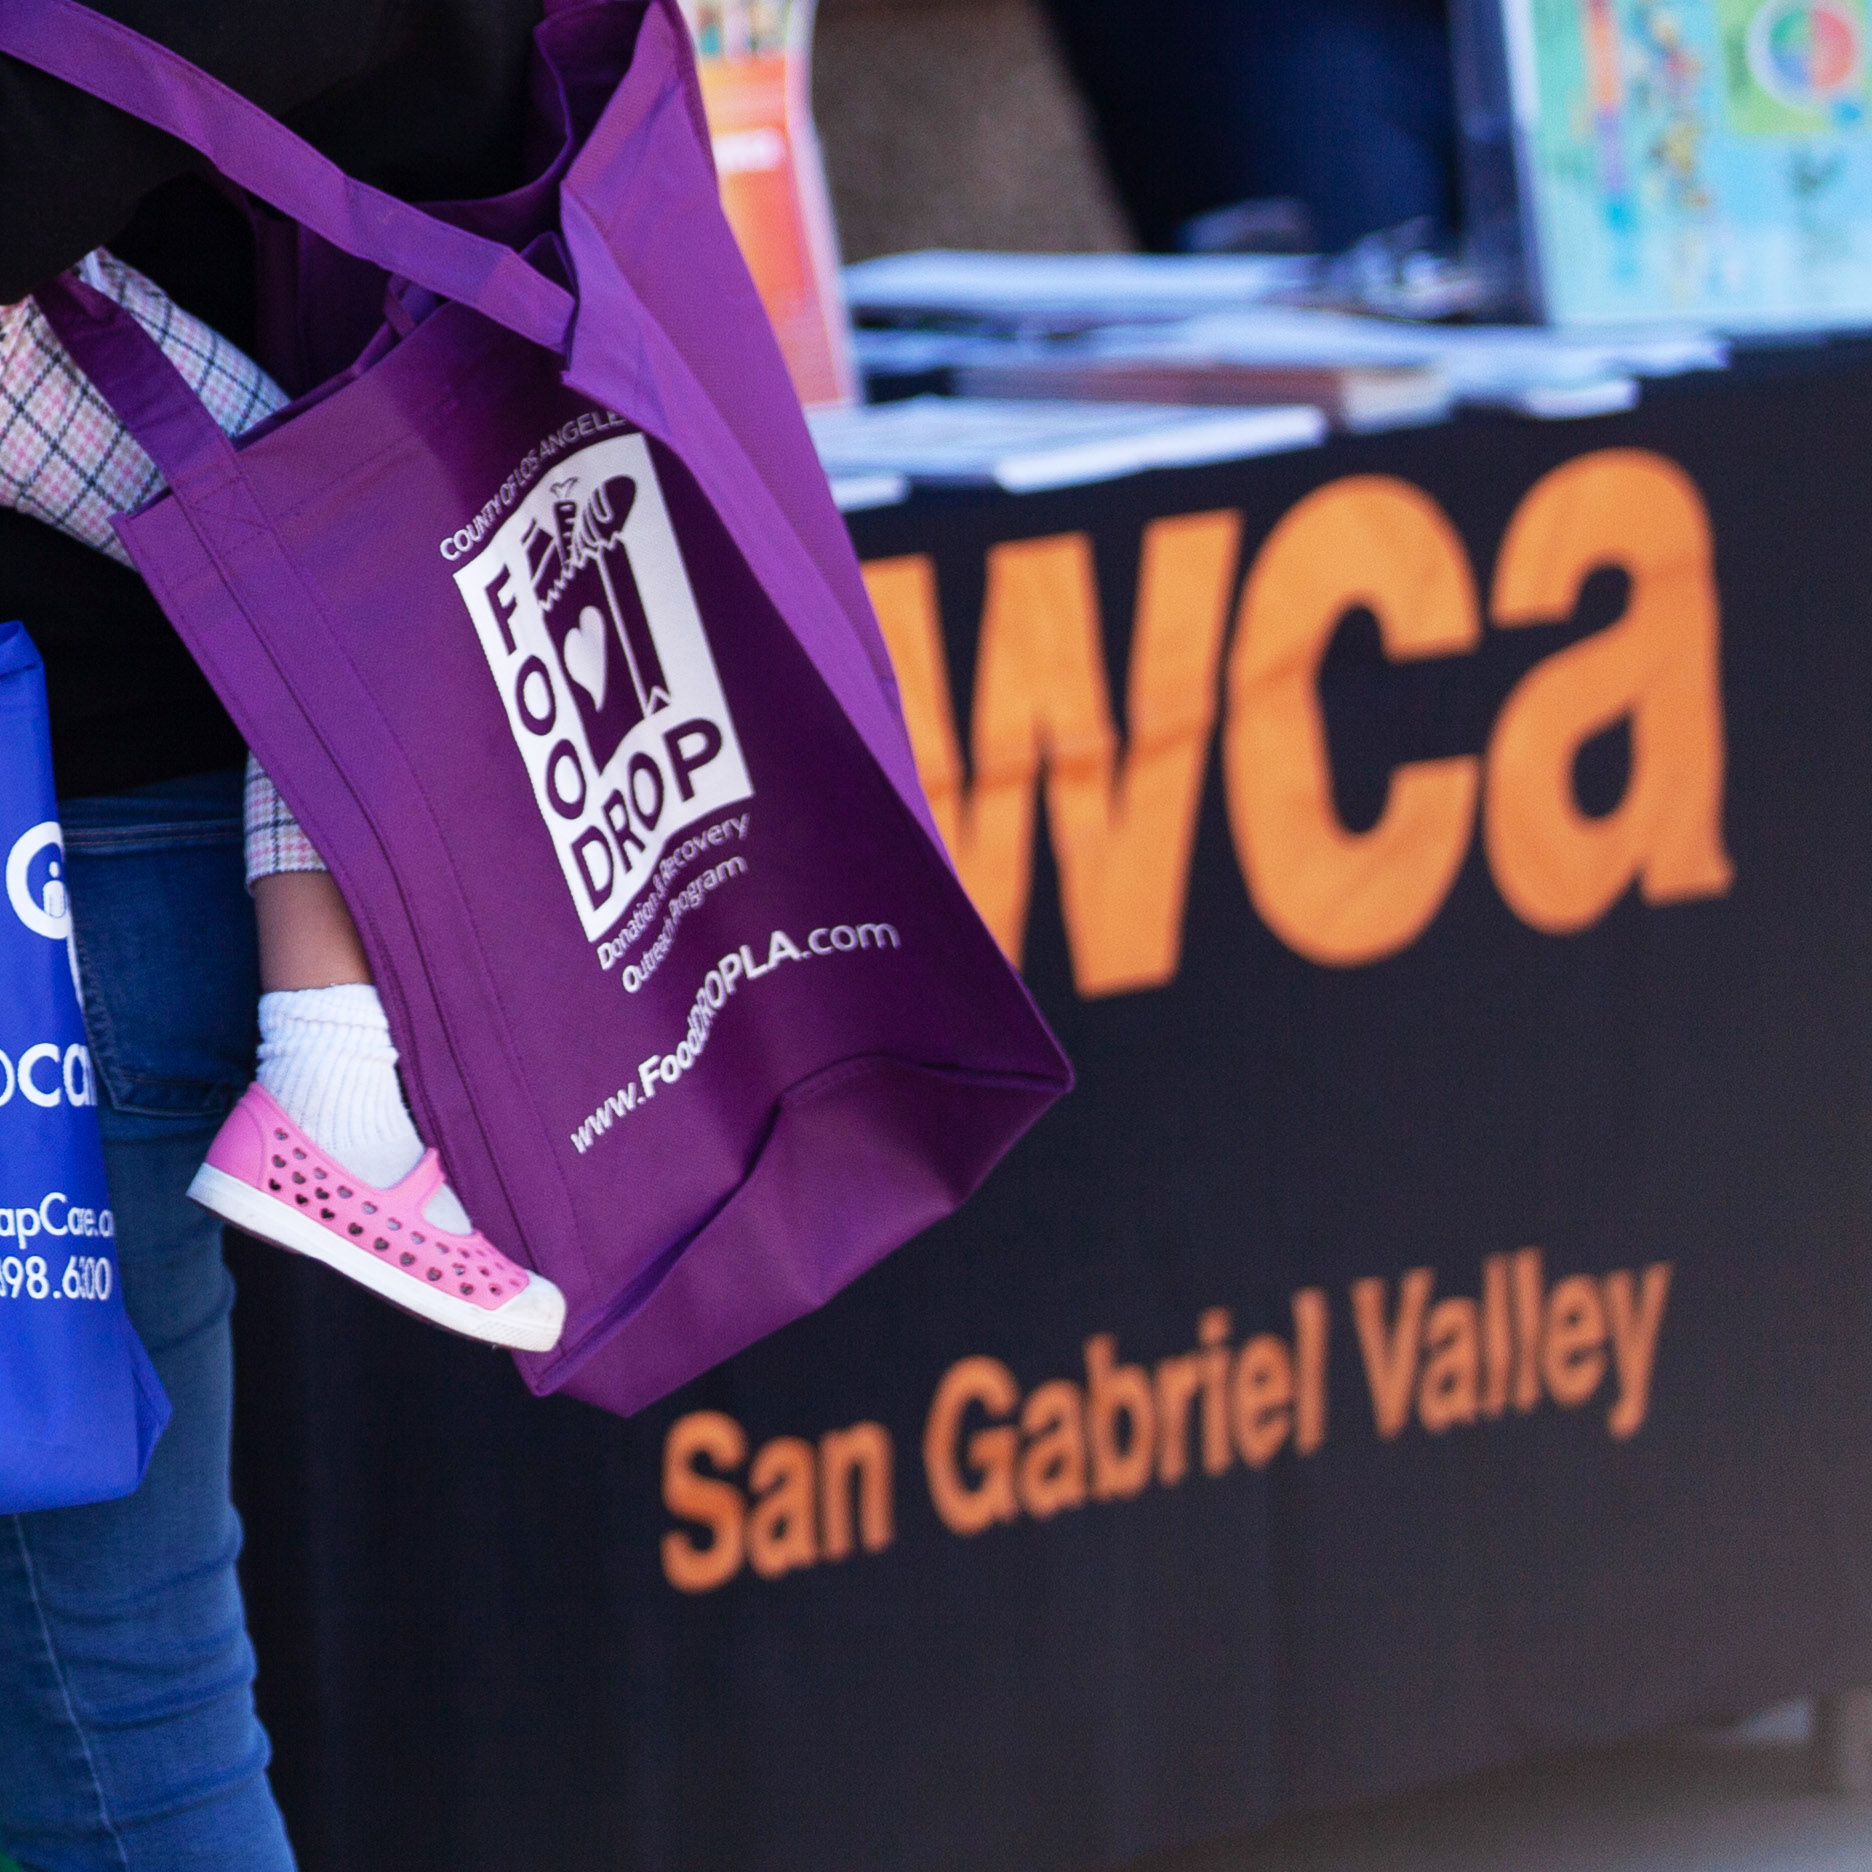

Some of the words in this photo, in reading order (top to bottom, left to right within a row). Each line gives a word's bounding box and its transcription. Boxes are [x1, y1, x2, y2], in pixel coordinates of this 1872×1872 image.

[440, 494, 504, 561] COUNTY
[499, 474, 519, 508] OF
[513, 448, 542, 488] LOS
[597, 891, 658, 971] Donation
[659, 812, 752, 888] Recovery
[622, 914, 680, 994] Outreach
[668, 855, 750, 923] Program
[663, 1409, 893, 1593] San
[923, 1288, 1330, 1534] Gabriel
[1349, 1247, 1672, 1439] Valley
